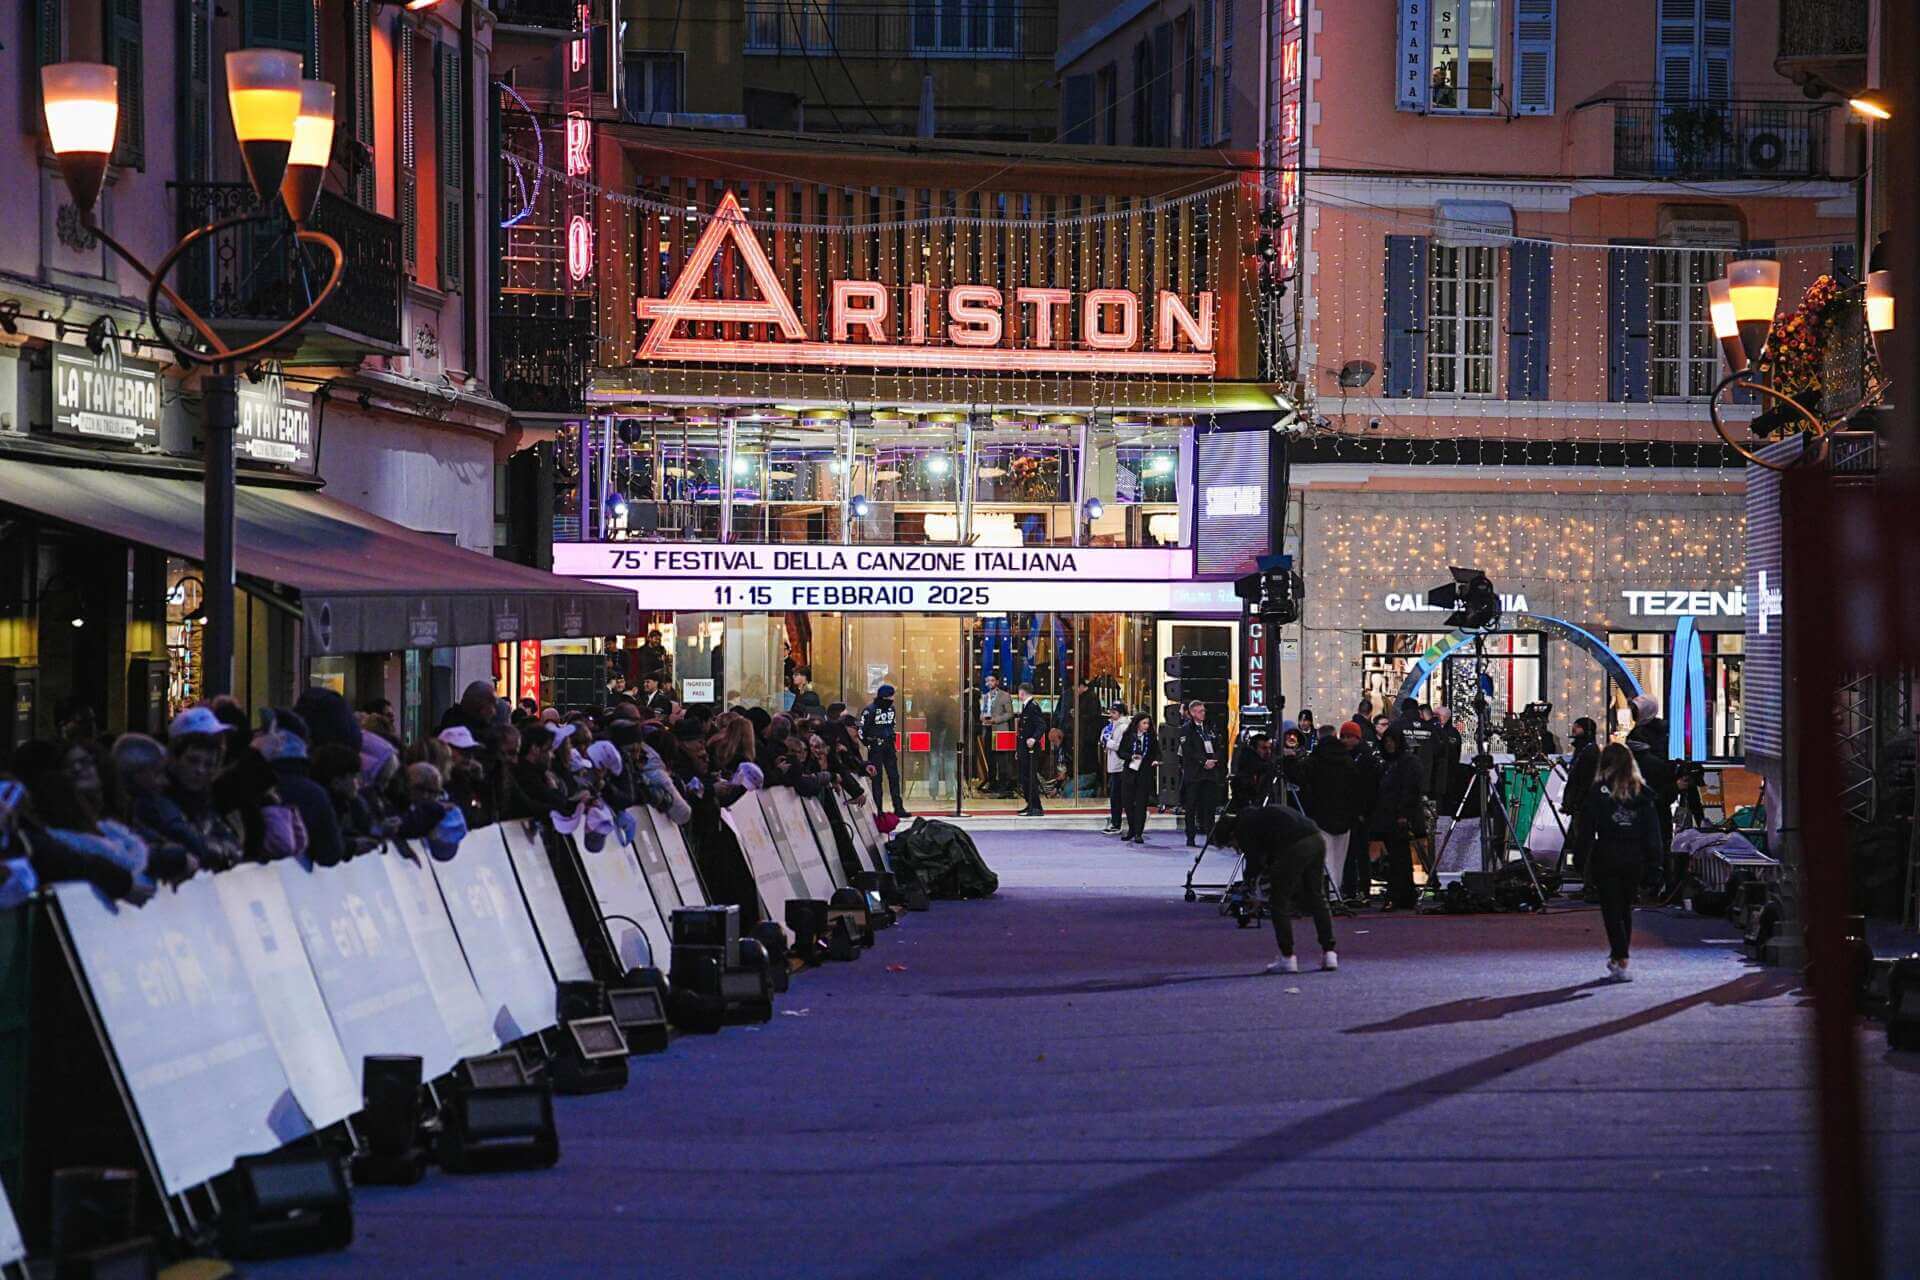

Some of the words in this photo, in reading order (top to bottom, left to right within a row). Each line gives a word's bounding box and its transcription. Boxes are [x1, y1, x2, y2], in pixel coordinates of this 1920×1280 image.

[1408, 4, 1418, 97] STAMPA
[635, 188, 1214, 366] ARISTON
[57, 365, 80, 409] LA
[83, 371, 156, 420] TAVERNA
[255, 403, 310, 444] TAVERNA
[653, 551, 764, 570] FESTIVAL
[774, 551, 848, 570] DELLA
[857, 551, 966, 571] CANZONE
[975, 552, 1078, 572] ITALIANA
[792, 586, 914, 605] FEBBRAIO
[927, 586, 990, 605] 2025
